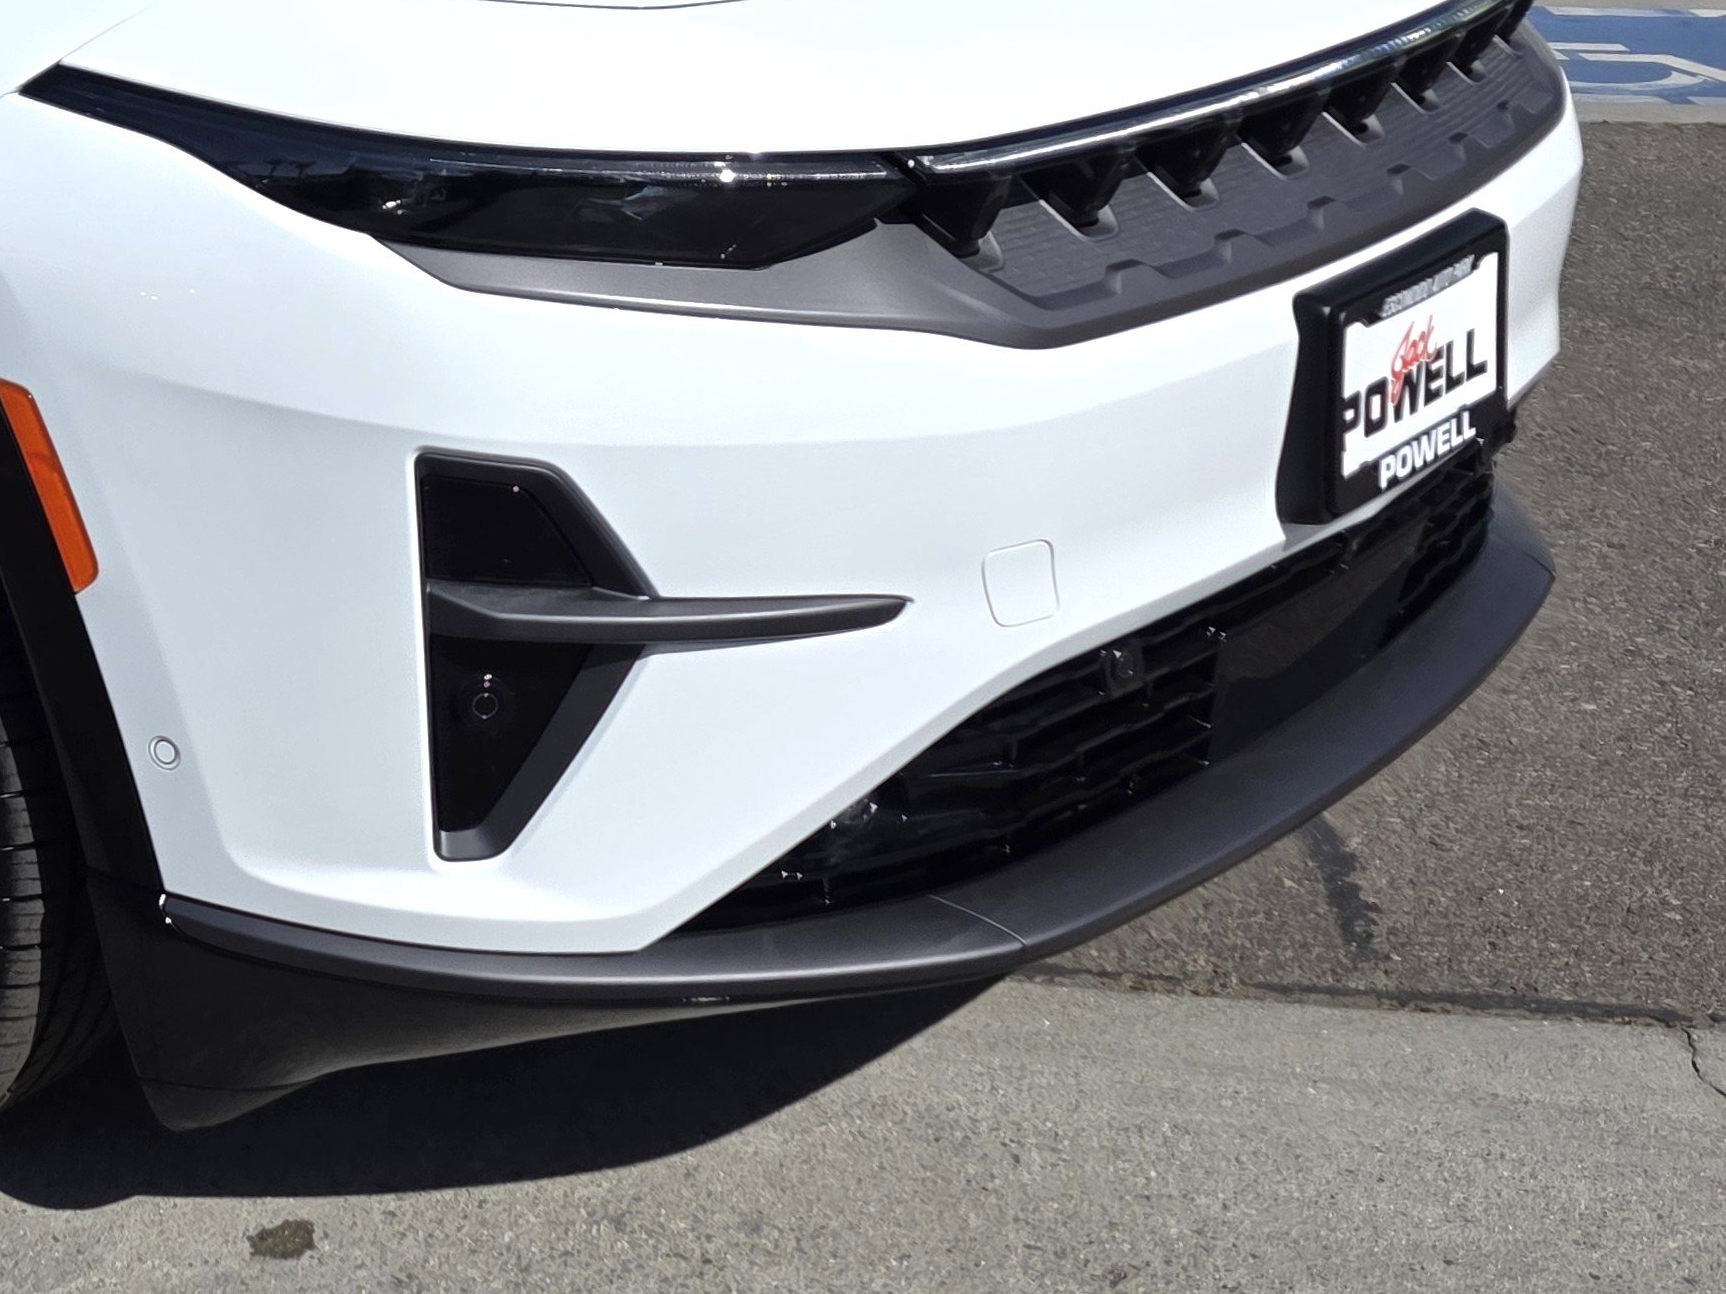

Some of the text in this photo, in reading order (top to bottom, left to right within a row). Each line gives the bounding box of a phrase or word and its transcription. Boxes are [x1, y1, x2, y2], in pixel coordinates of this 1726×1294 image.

[1340, 328, 1489, 448] POWELL
[1390, 314, 1438, 406] Jack
[1378, 410, 1477, 491] POWELL
